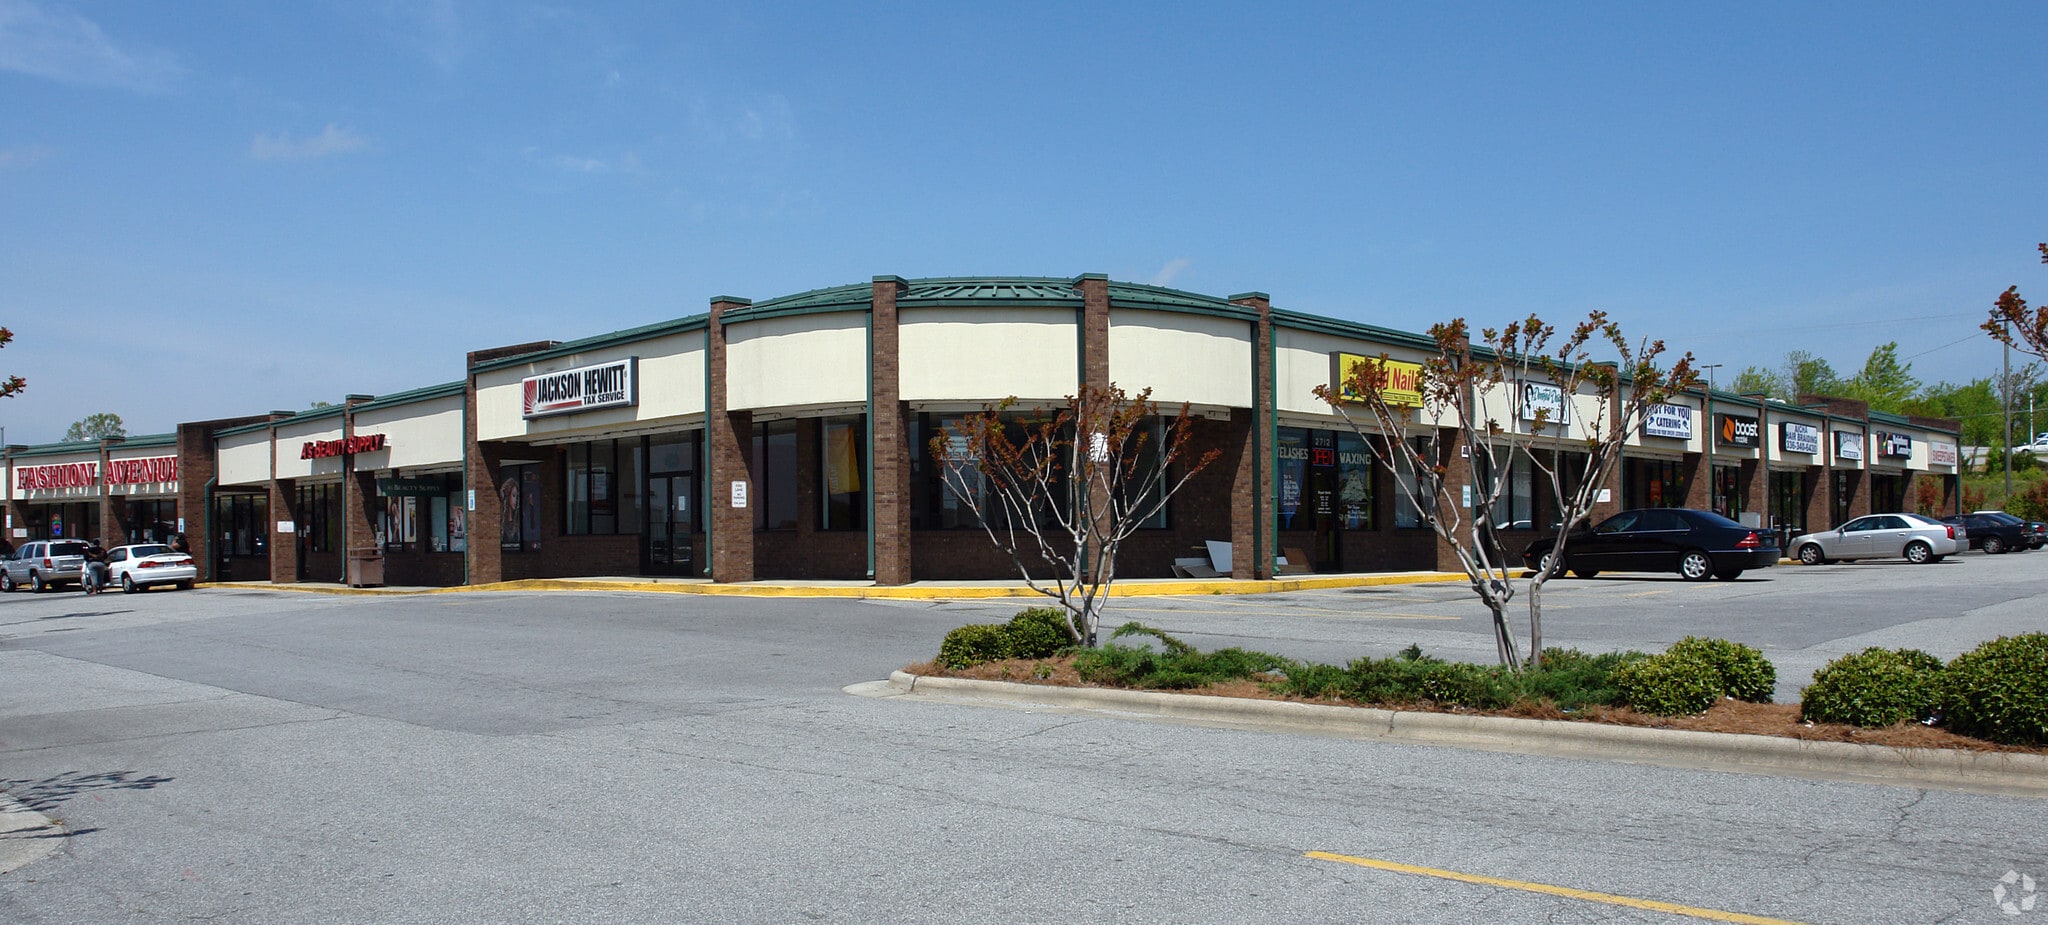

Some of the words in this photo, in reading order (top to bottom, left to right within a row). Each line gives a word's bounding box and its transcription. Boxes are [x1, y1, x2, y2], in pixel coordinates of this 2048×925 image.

[537, 372, 581, 403] JACKSON
[585, 364, 625, 395] HEWITT
[583, 396, 596, 406] TAX
[597, 390, 625, 403] SERVICE
[1648, 403, 1662, 415] UST
[1664, 404, 1676, 416] FOR
[1678, 406, 1690, 421] YOU
[1656, 416, 1681, 430] CATERING
[1735, 418, 1759, 437] boost
[314, 439, 346, 459] BEAUTY
[347, 433, 386, 454] SUPPLY
[1339, 452, 1372, 465] WAXING
[17, 463, 97, 490] FASHION
